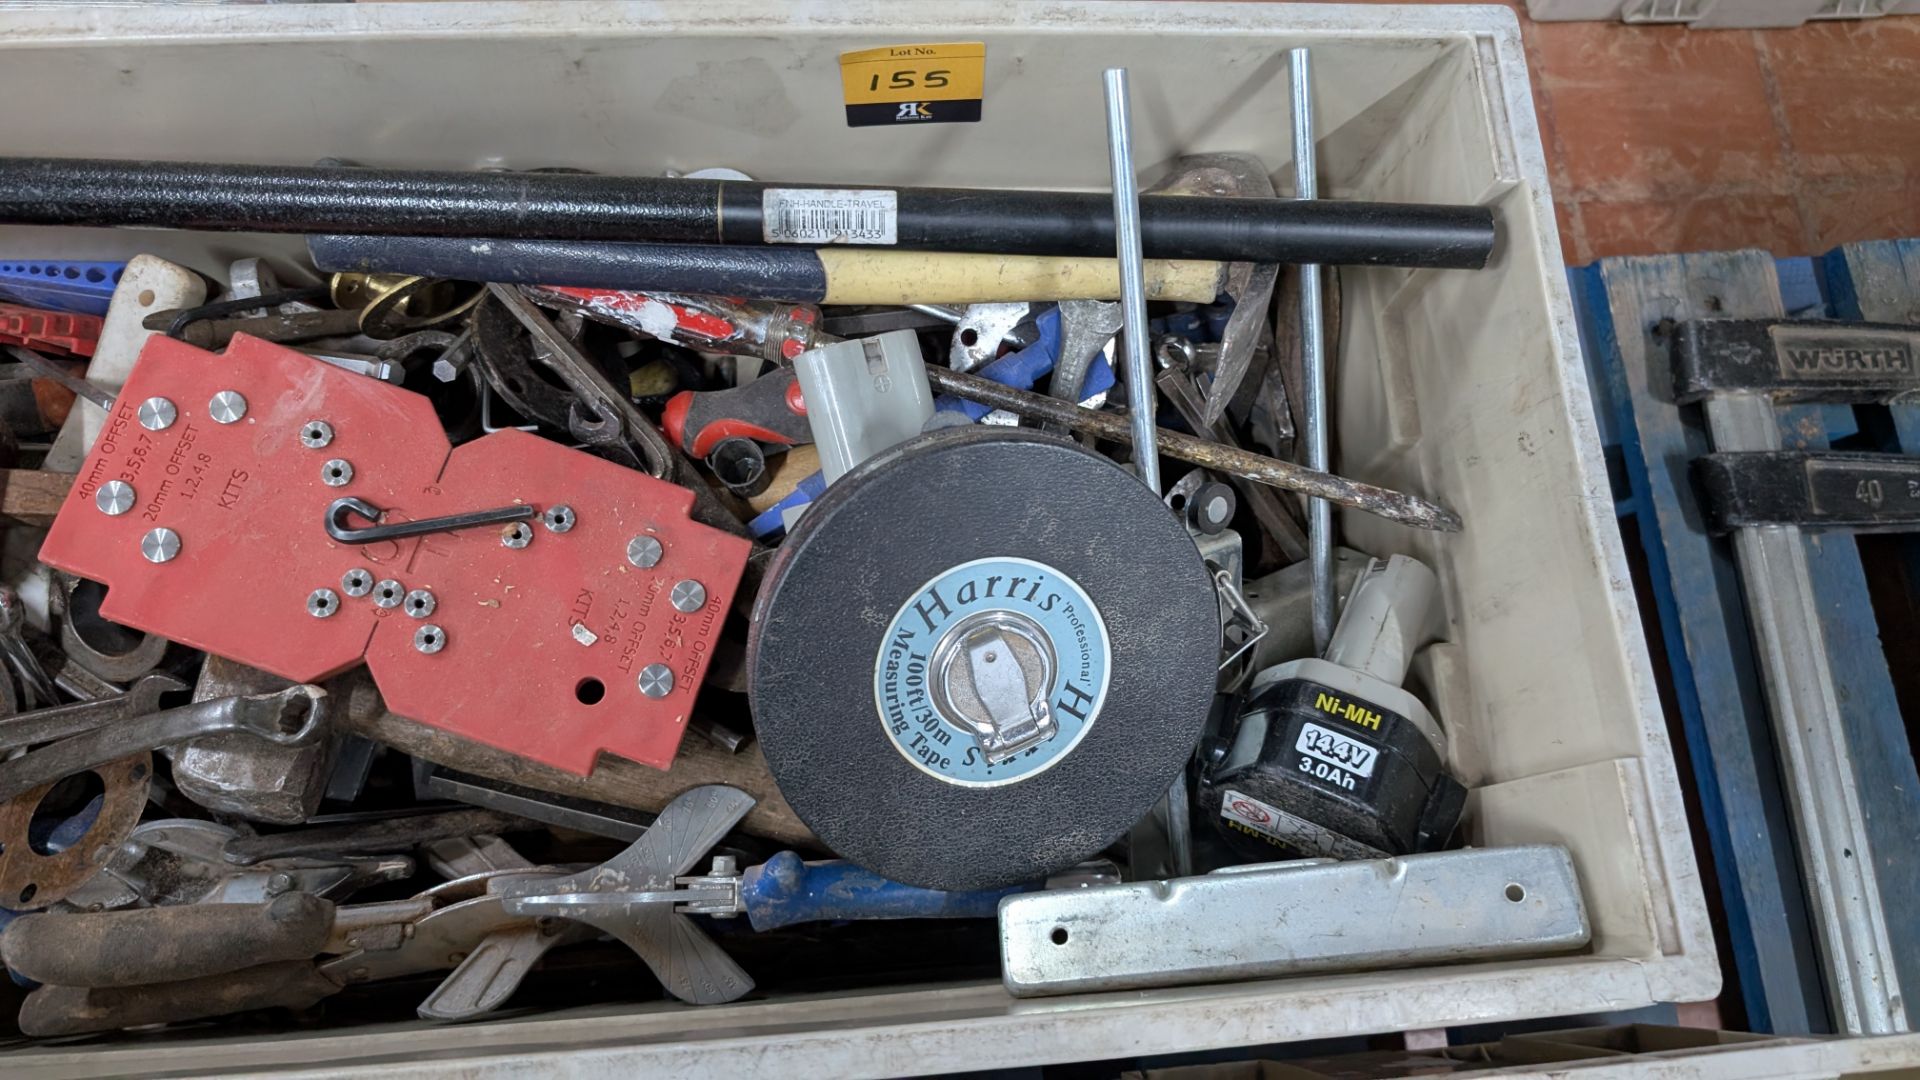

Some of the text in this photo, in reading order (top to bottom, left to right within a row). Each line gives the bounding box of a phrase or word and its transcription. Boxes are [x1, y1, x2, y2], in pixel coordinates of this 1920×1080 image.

[890, 48, 936, 57] Lot No.
[870, 70, 951, 91] 155
[1785, 348, 1910, 373] WÜRTH
[78, 402, 135, 500] 40mm OFFSET
[142, 423, 199, 522] 20mm OFFSET
[180, 452, 212, 500] 1,2,4,8
[217, 467, 249, 511] KITS
[603, 597, 631, 645] 1,2,4,8
[913, 575, 1062, 635] Harris
[618, 620, 647, 674] OFFSET
[678, 595, 723, 694] 40mm OFFSET
[885, 626, 951, 771] Measuring Tape
[905, 652, 952, 747] 100ft/30m
[1314, 692, 1383, 731] Ni-MH
[1305, 728, 1371, 770] 14.4V
[1298, 756, 1357, 791] 3.0Ah
